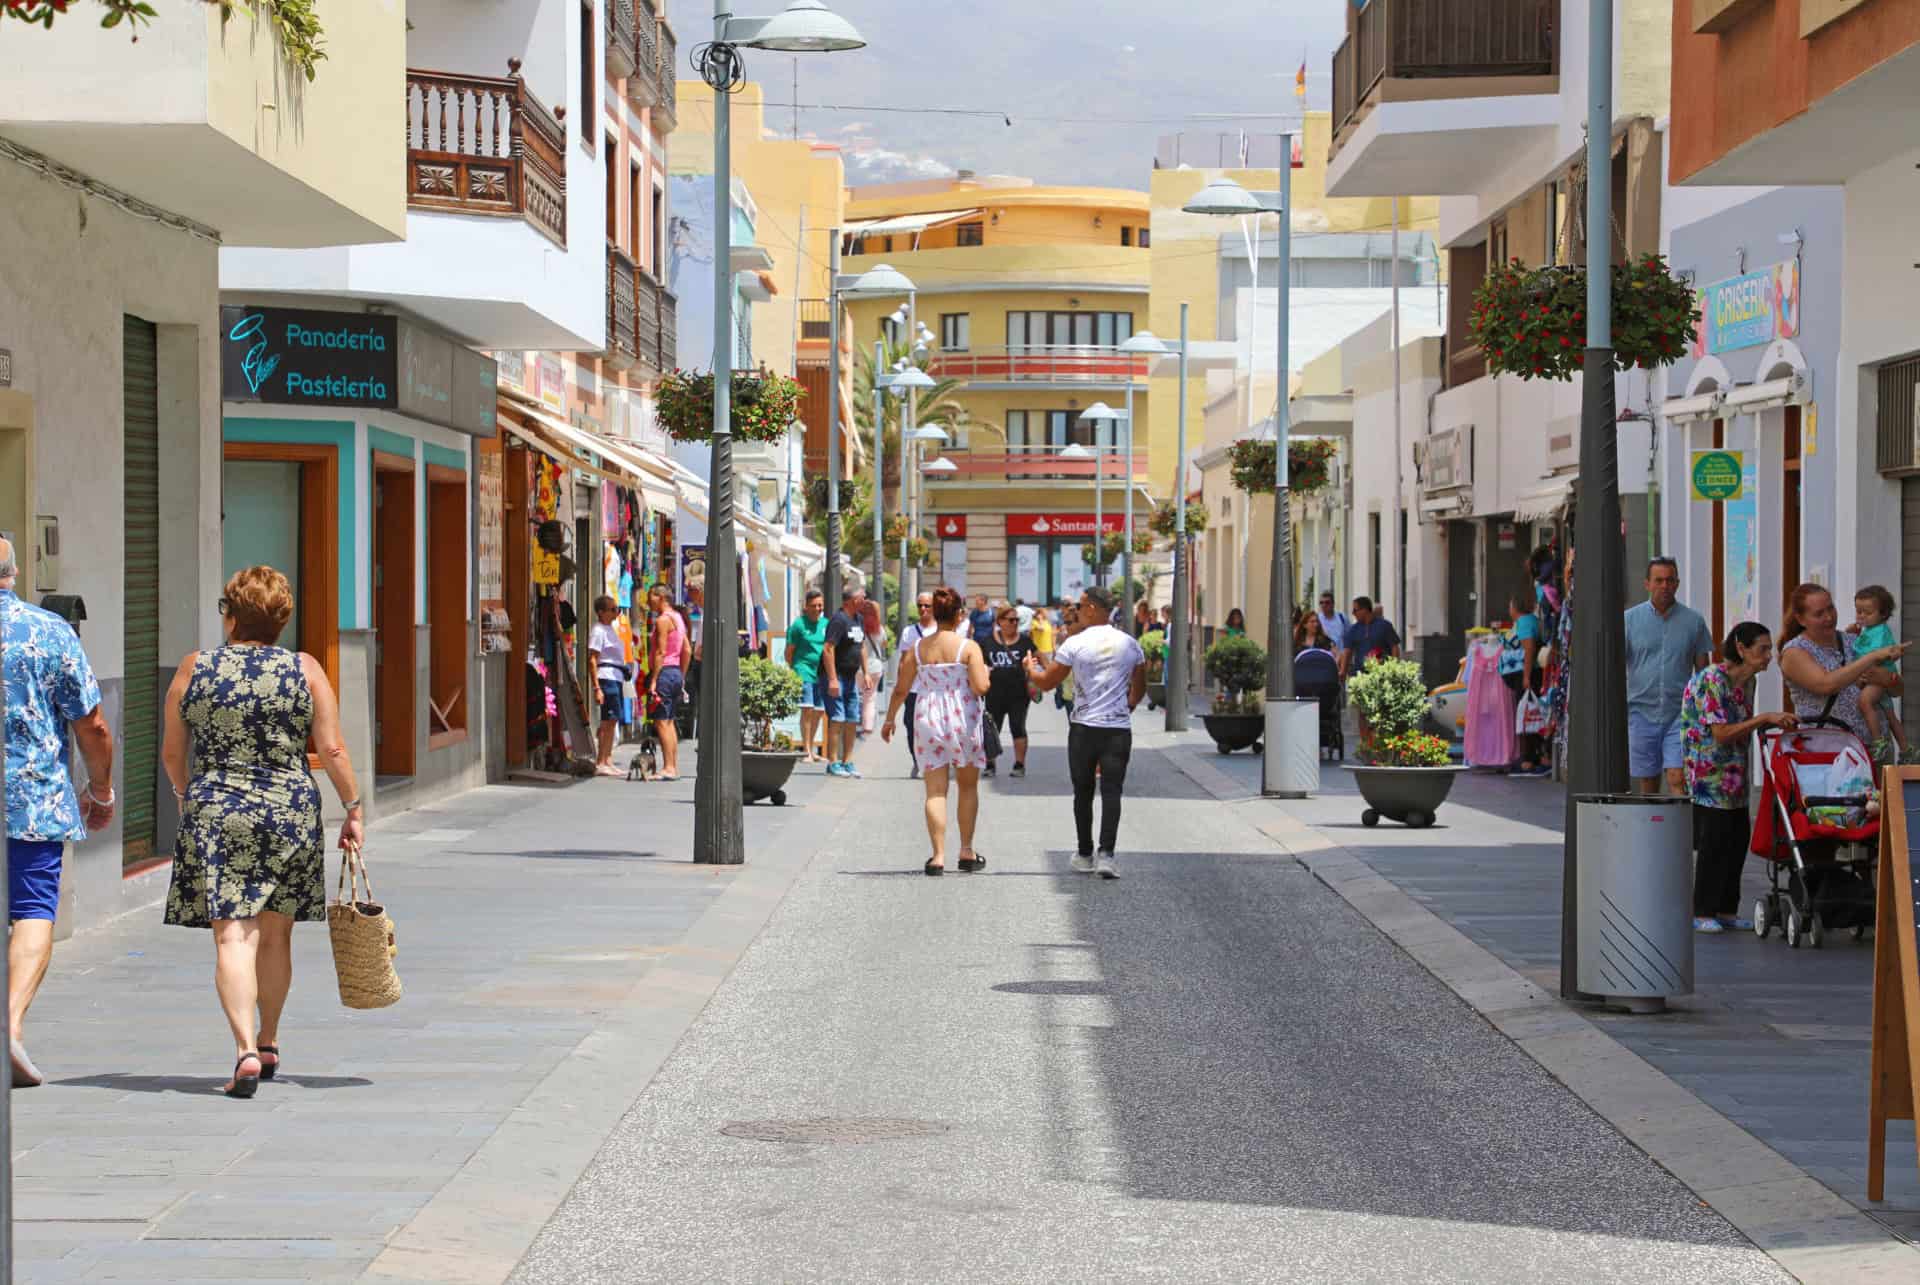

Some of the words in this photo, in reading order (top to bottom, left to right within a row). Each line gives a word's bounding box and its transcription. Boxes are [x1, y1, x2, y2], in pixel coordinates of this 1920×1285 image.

[286, 323, 385, 352] Panadería
[286, 372, 387, 400] Pastelería
[1052, 518, 1114, 532] Santaner
